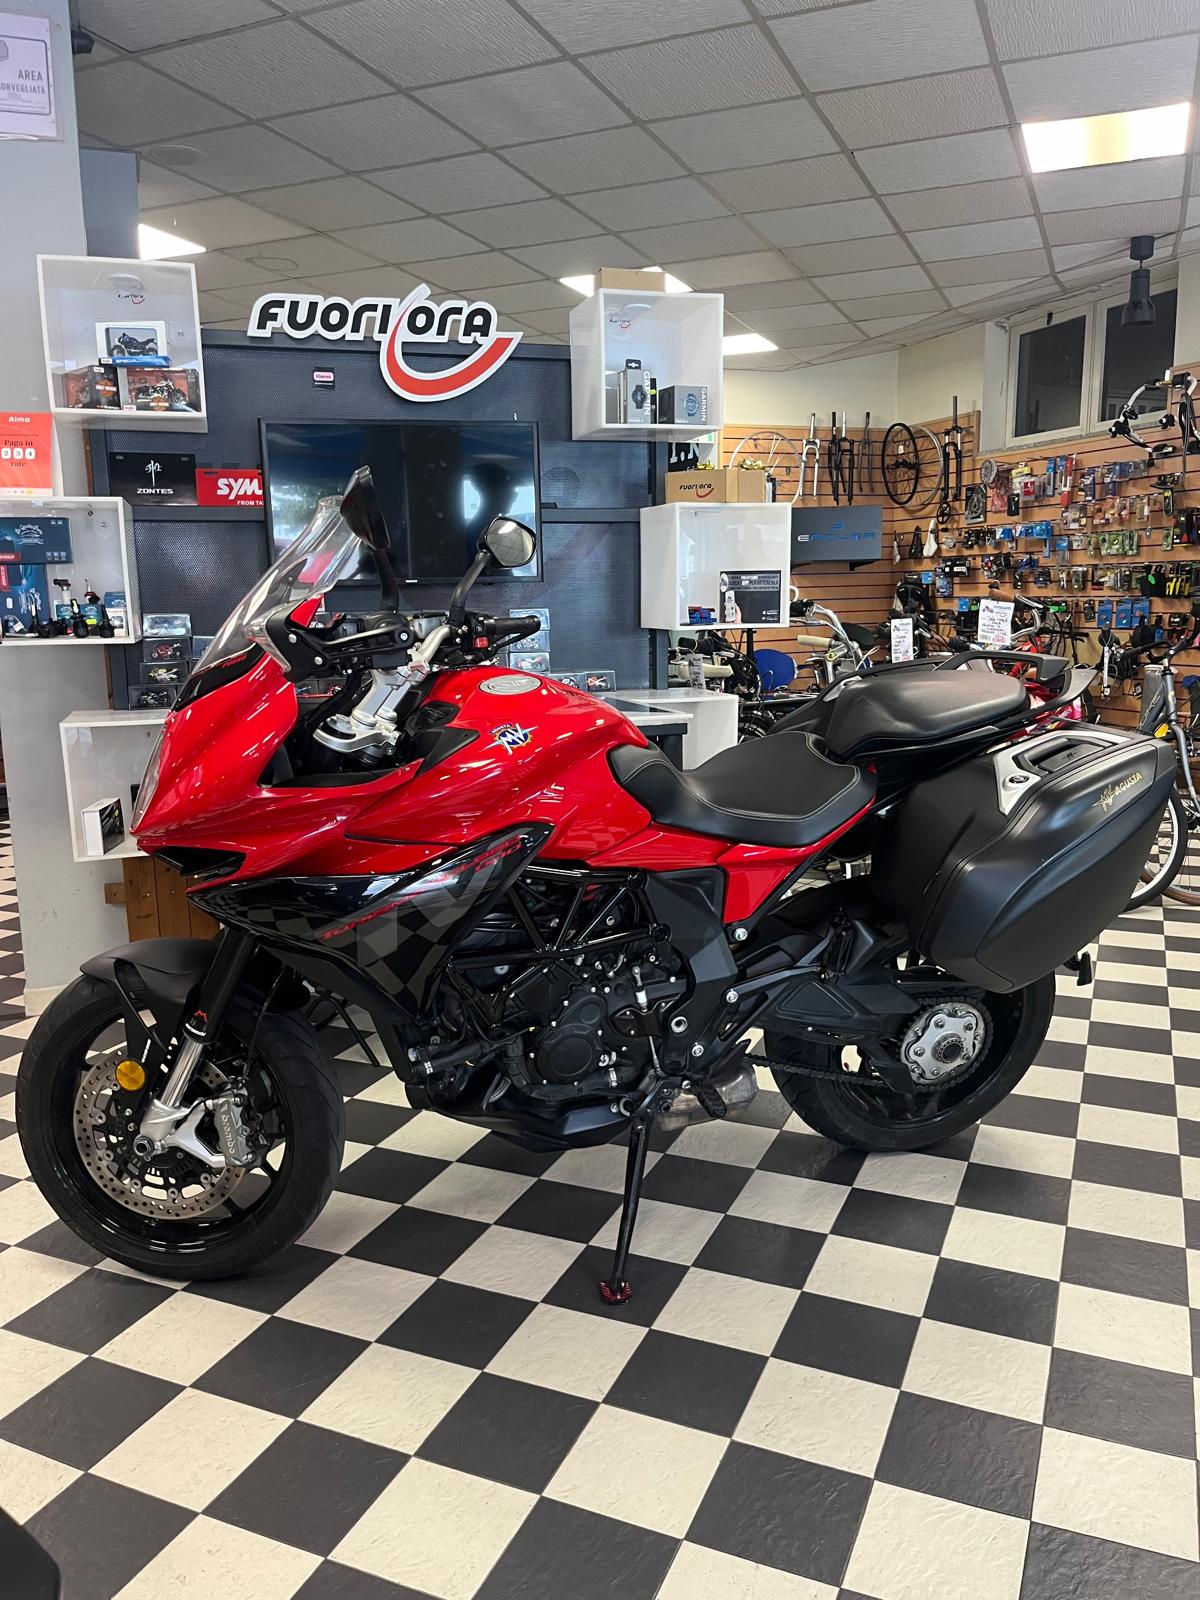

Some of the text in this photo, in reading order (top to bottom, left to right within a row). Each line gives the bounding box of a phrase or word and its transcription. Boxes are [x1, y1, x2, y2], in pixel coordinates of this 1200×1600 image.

[18, 70, 43, 81] AREA
[217, 478, 263, 500] SYM
[1114, 772, 1143, 796] AGUSTA
[221, 1114, 236, 1154] brembo
